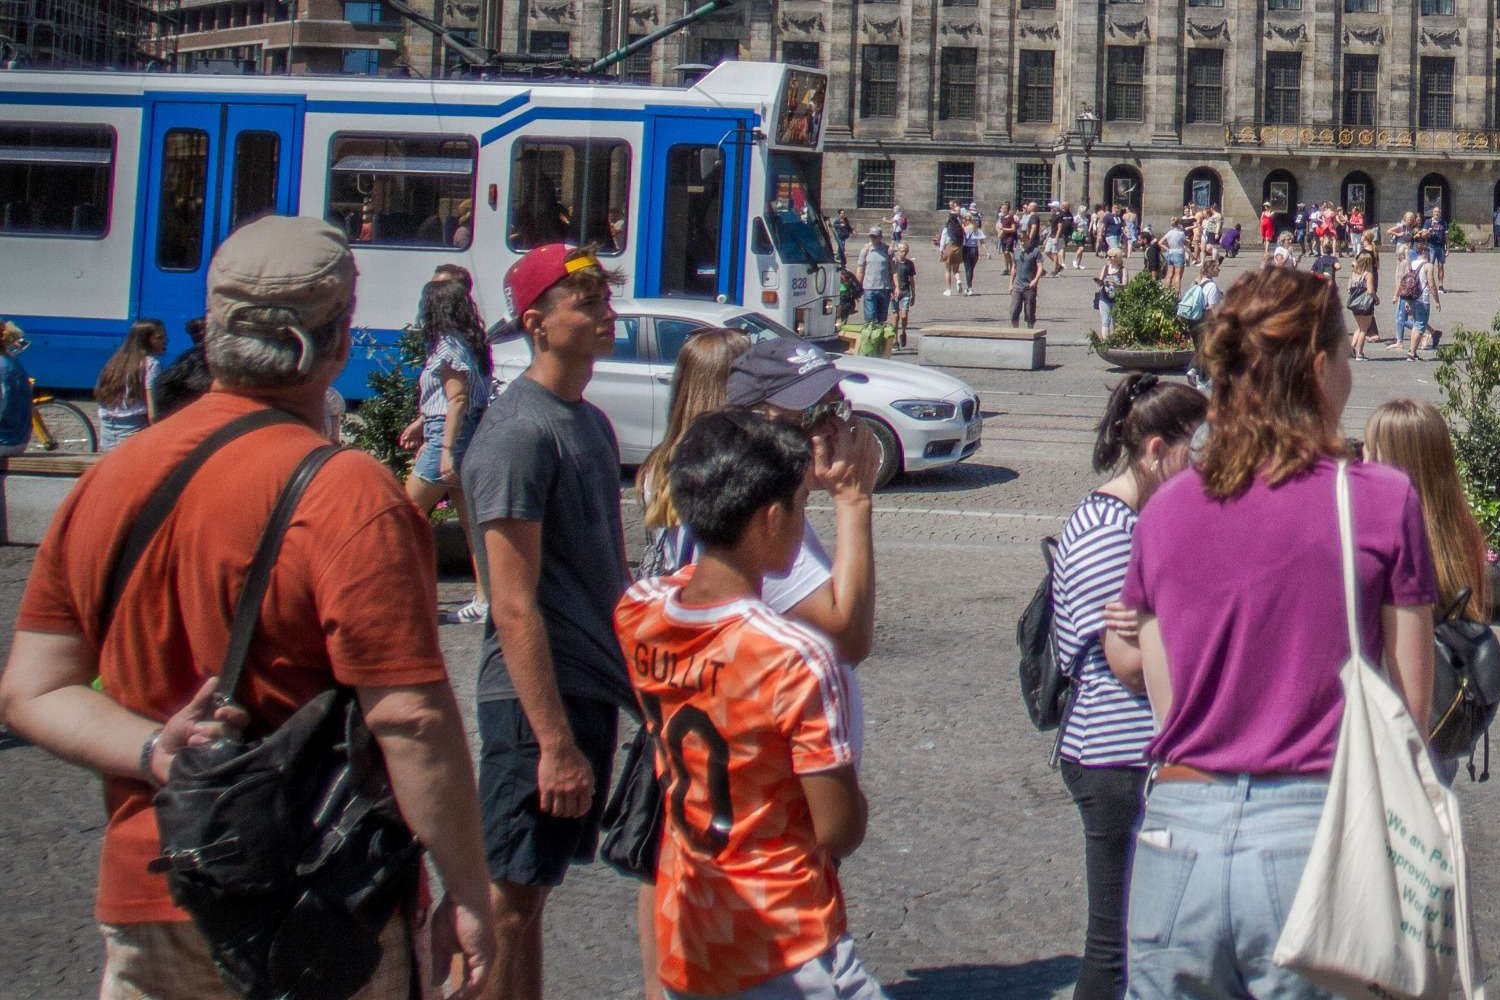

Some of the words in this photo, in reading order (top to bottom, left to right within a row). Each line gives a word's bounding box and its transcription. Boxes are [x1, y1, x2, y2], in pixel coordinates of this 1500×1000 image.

[791, 277, 808, 290] 828
[633, 642, 725, 697] GULLIT
[1402, 883, 1440, 923] World
